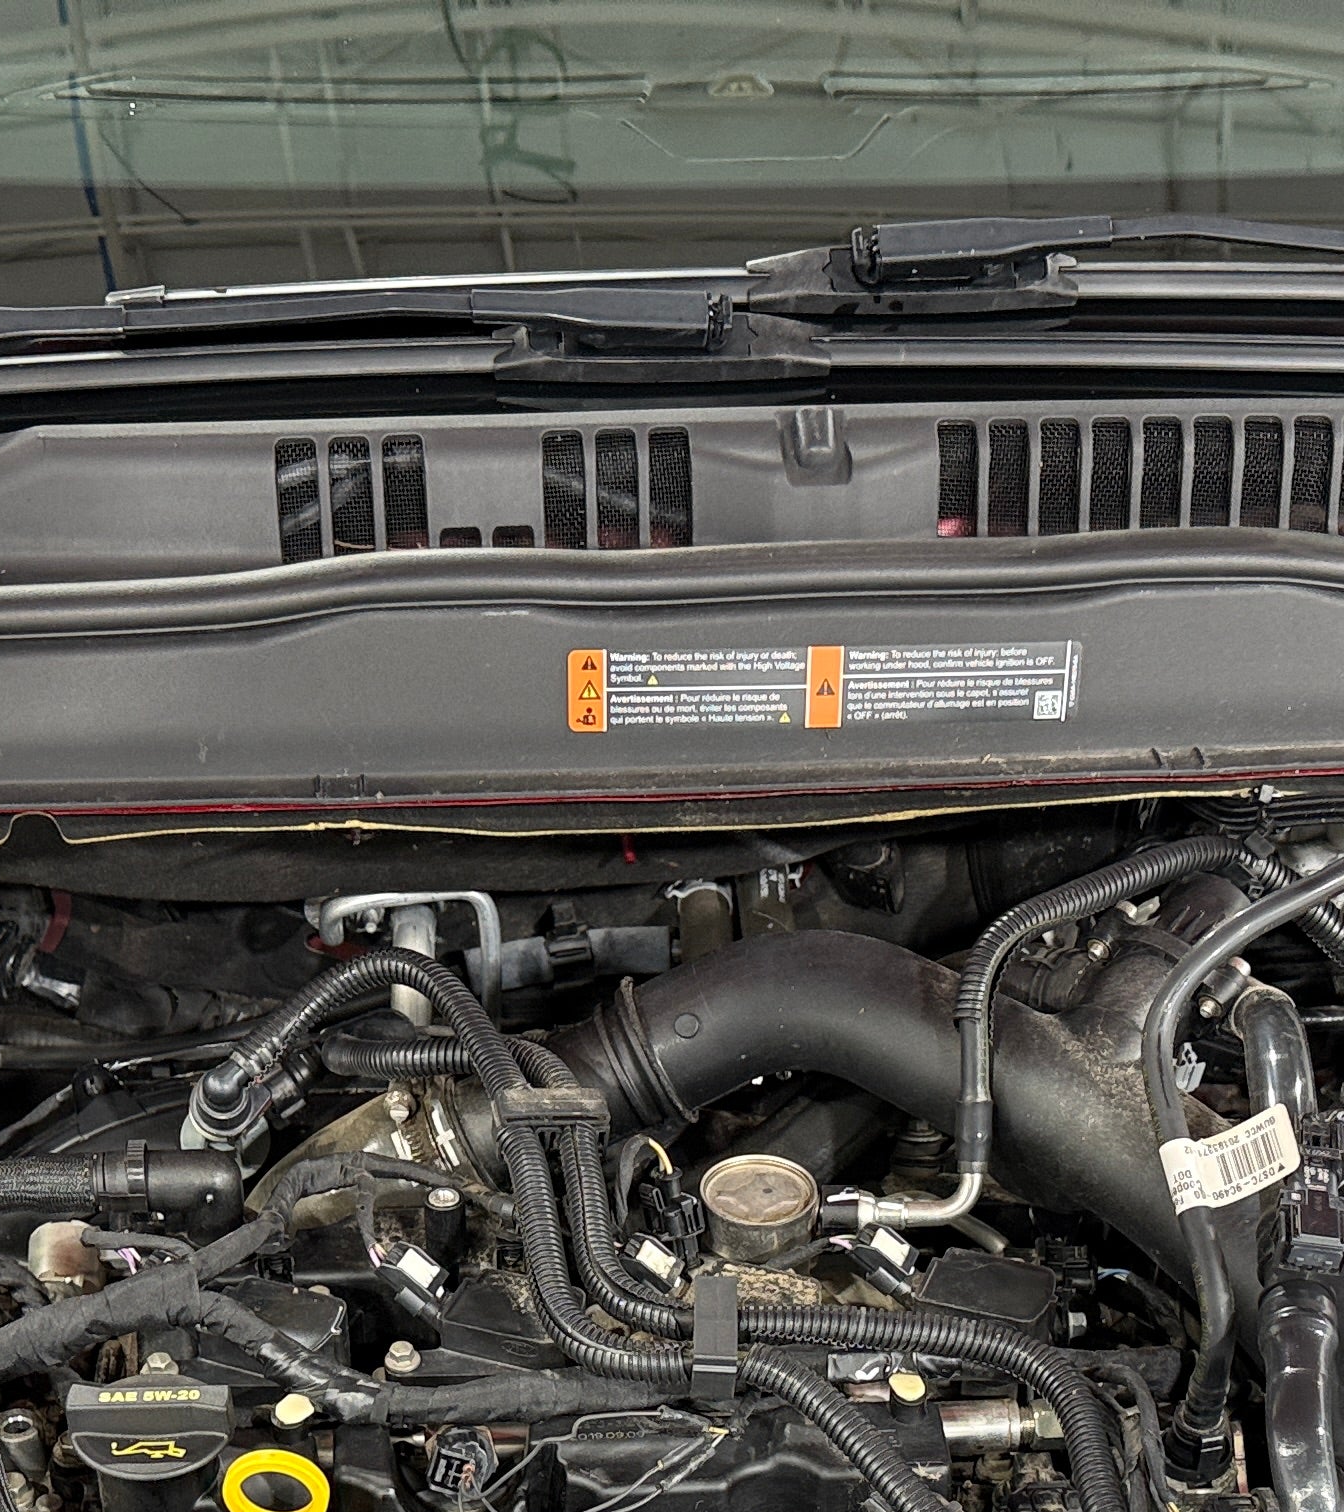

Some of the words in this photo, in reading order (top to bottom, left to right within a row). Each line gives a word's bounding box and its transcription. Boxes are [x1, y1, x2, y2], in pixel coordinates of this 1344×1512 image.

[610, 652, 651, 664] Warning:
[652, 652, 663, 661] To
[663, 652, 693, 661] reduce
[694, 652, 708, 661] the
[709, 652, 725, 661] risk
[726, 652, 735, 660] of
[736, 652, 757, 663] injury
[849, 650, 889, 662] Warning:
[891, 650, 901, 659] To
[902, 650, 931, 659] reduce
[932, 649, 946, 658] the
[947, 649, 962, 658] risk
[964, 649, 973, 657] of
[1000, 648, 1027, 657] before
[610, 662, 633, 673] avoid
[634, 663, 685, 674] components
[686, 662, 718, 672] marked
[719, 662, 736, 671] with
[738, 662, 752, 671] the
[753, 662, 772, 673] High
[774, 661, 805, 672] Voltage
[848, 660, 881, 672] working
[883, 661, 906, 670] under
[933, 659, 963, 668] confirm
[965, 658, 994, 668] vehicle
[995, 658, 1025, 669] ignition
[1026, 658, 1034, 666] is
[848, 679, 909, 690] Avertissement
[916, 679, 935, 688] Pour
[967, 678, 974, 687] le
[976, 678, 1001, 688] risque
[1002, 677, 1013, 686] de
[1015, 677, 1053, 686] blessures
[610, 694, 673, 704] Avertissement
[680, 694, 701, 703] Pour
[733, 693, 741, 702] le
[742, 693, 768, 704] risque
[769, 692, 780, 702] de
[887, 689, 934, 699] intervention
[936, 690, 955, 698] sous
[956, 689, 964, 697] le
[610, 704, 650, 714] blessures
[651, 706, 662, 714] ou
[664, 704, 675, 713] de
[724, 703, 736, 712] les
[737, 703, 788, 714] composants
[847, 702, 862, 712] que
[863, 701, 872, 710] le
[873, 700, 925, 710] commutateur
[972, 700, 985, 708] est
[998, 698, 1029, 708] position
[610, 715, 623, 726] qui
[625, 714, 654, 726] portent
[655, 714, 664, 723] le
[664, 713, 700, 726] symbole
[708, 713, 734, 723] Haute
[735, 713, 765, 722] tension
[854, 711, 872, 719] OFF
[98, 1391, 138, 1403] SAE
[143, 1389, 201, 1401] 5W-20
